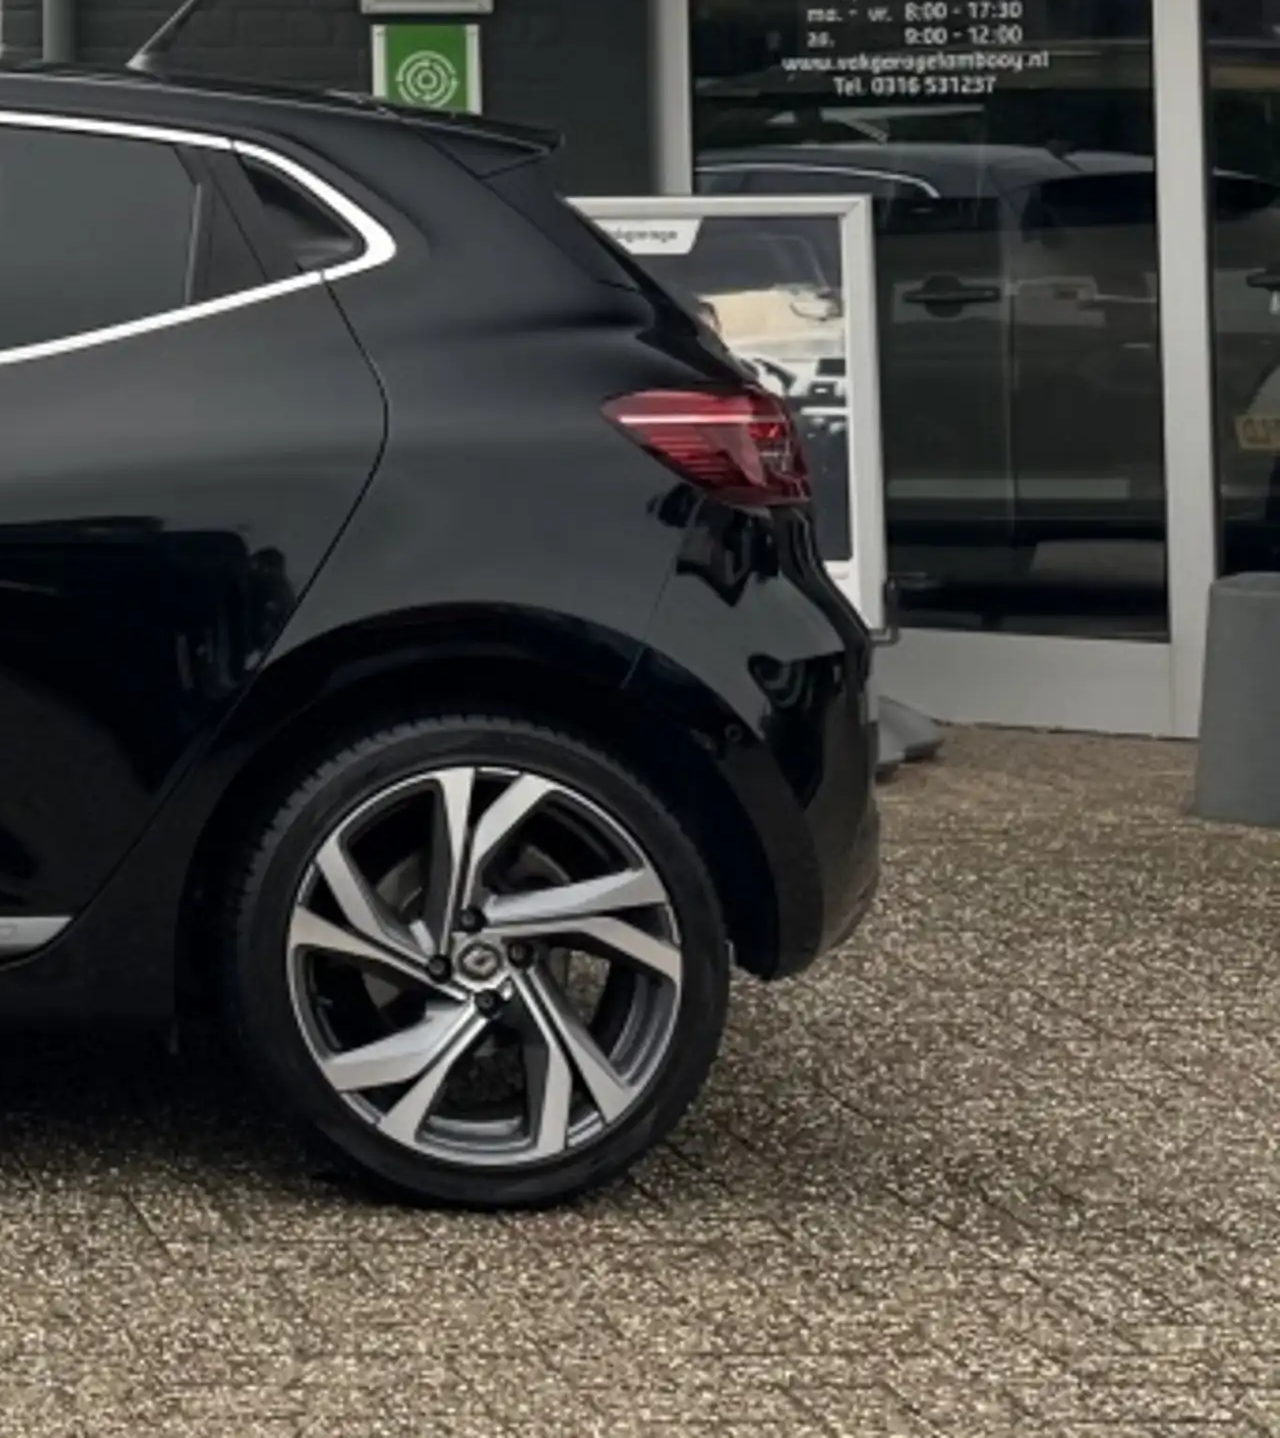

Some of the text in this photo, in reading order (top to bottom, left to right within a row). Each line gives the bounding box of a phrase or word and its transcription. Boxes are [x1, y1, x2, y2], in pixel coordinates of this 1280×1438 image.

[806, 8, 842, 22] ma.
[904, 0, 948, 22] 8:00
[967, 0, 1024, 19] 17:30
[904, 25, 948, 45] 9:00
[967, 24, 1024, 45] 12:00
[870, 76, 920, 97] 0316
